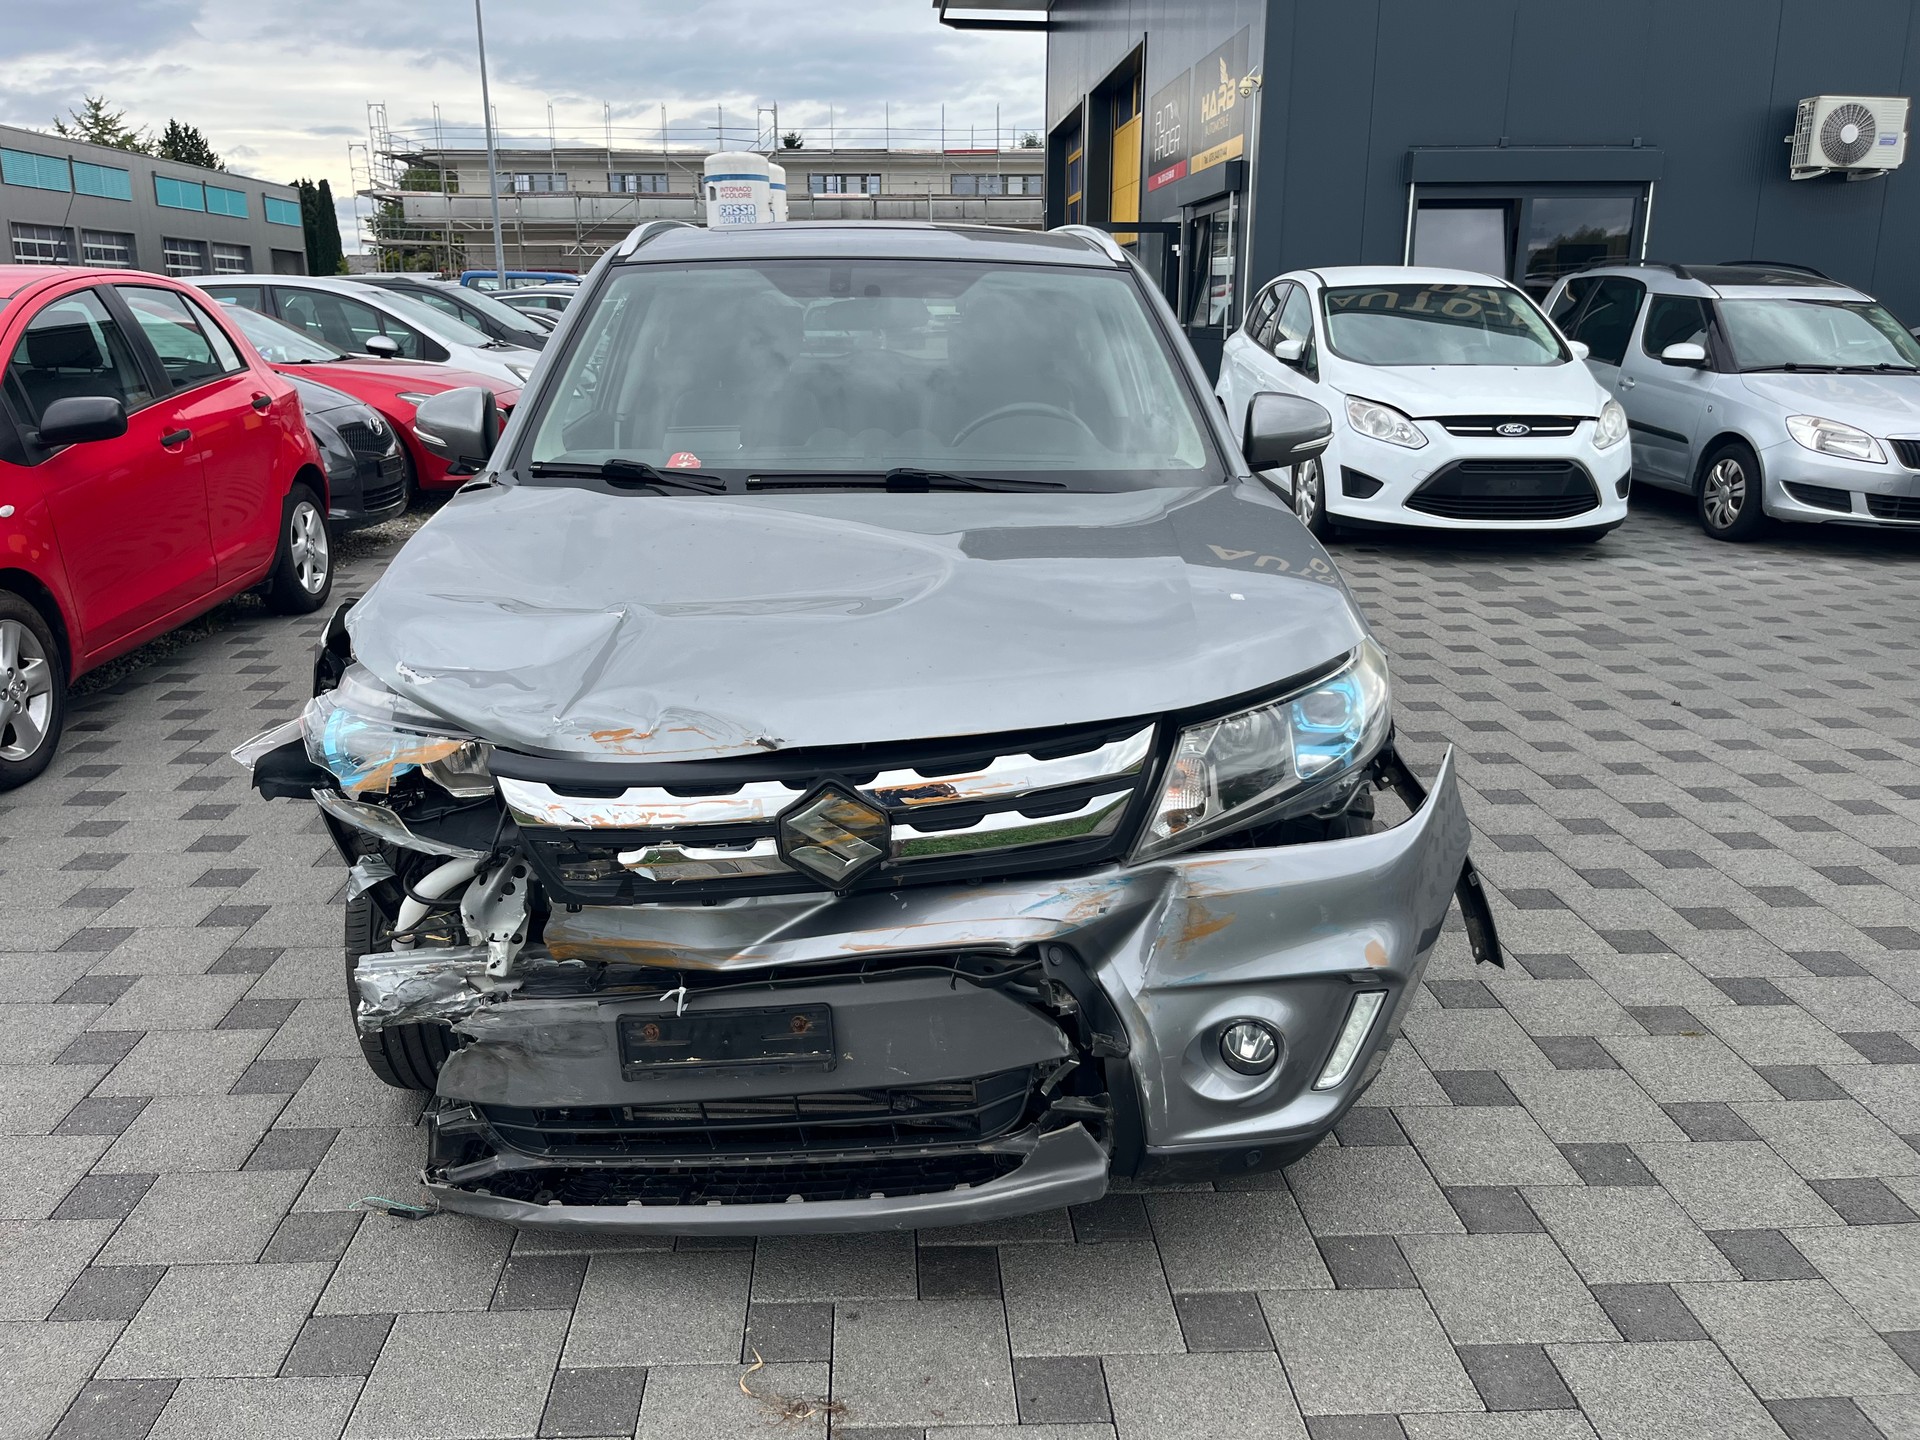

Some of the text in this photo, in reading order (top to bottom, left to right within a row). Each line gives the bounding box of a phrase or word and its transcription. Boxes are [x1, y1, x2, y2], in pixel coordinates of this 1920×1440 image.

[1201, 78, 1236, 123] HARB
[719, 203, 756, 216] FASSA
[1504, 423, 1523, 433] Ford
